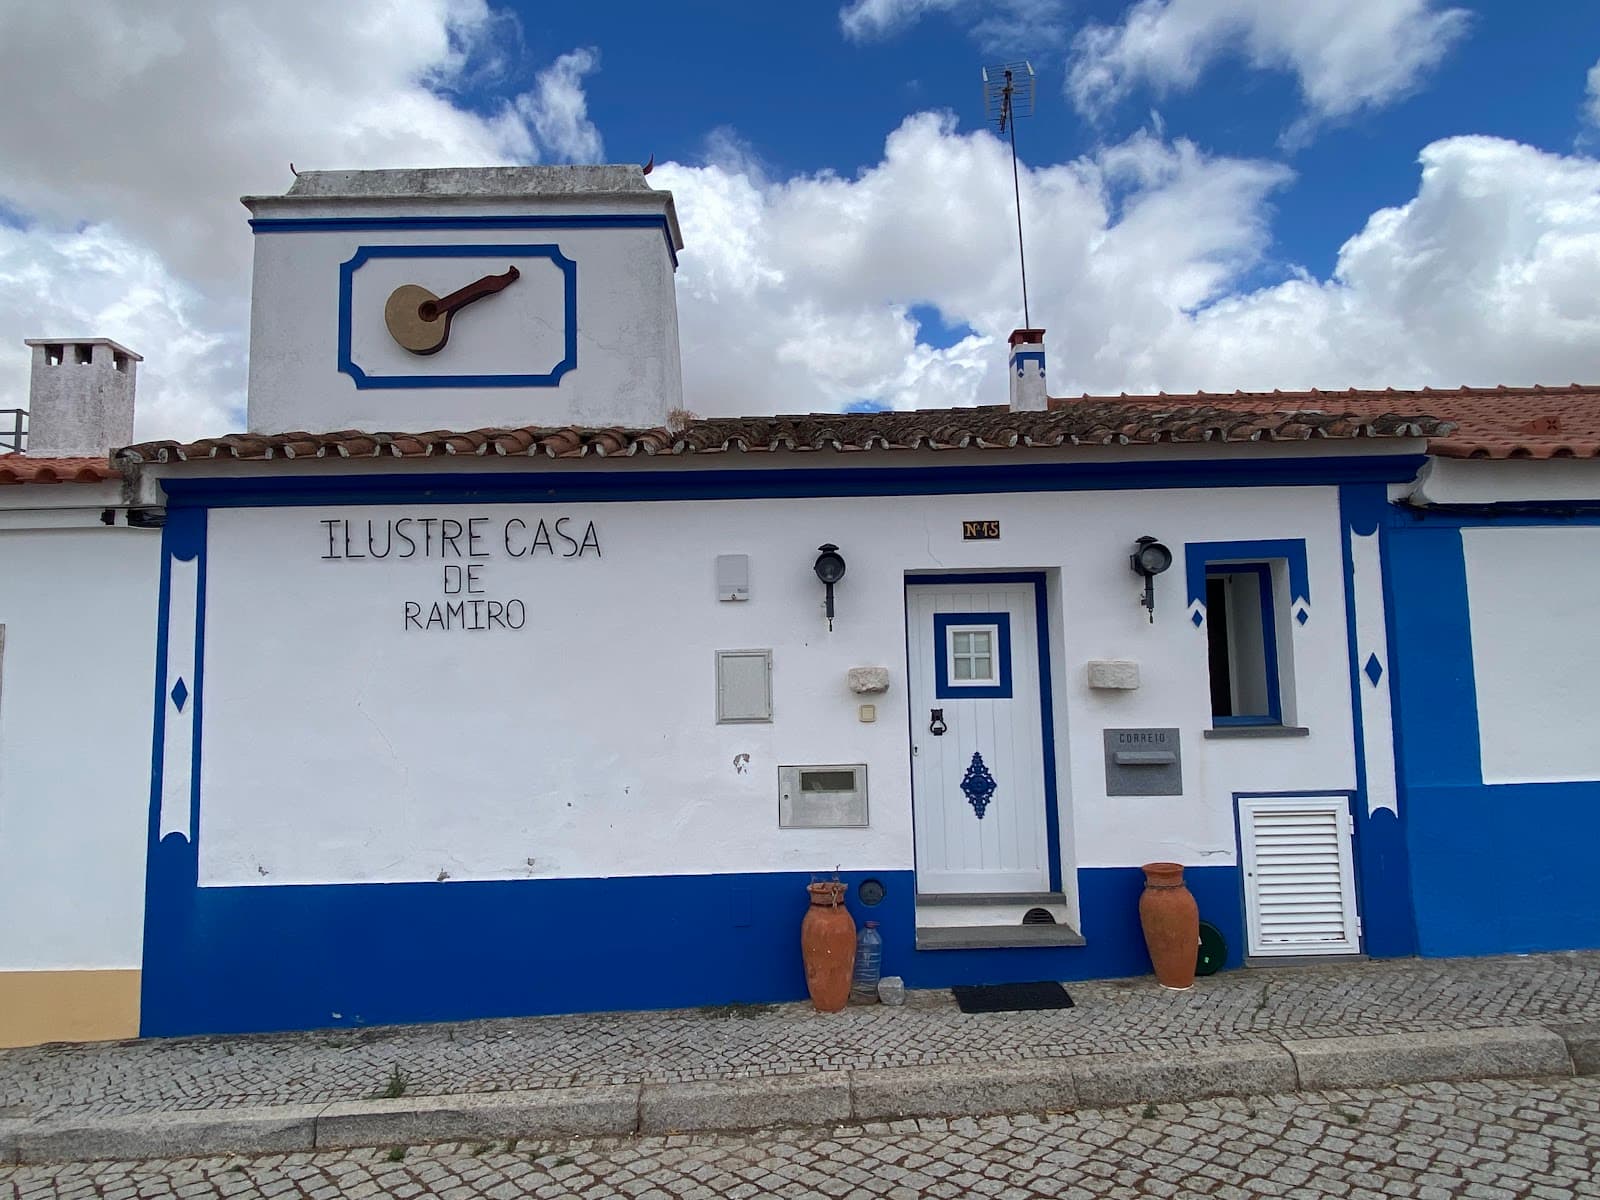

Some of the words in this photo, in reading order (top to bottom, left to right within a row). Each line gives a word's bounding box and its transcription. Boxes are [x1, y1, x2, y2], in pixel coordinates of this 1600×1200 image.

[320, 518, 490, 559] ILUSTRE
[504, 517, 601, 557] CASA
[982, 521, 998, 537] 15
[444, 564, 485, 594] DE
[405, 598, 526, 631] RAMIRO
[1119, 733, 1165, 743] CORREIO
